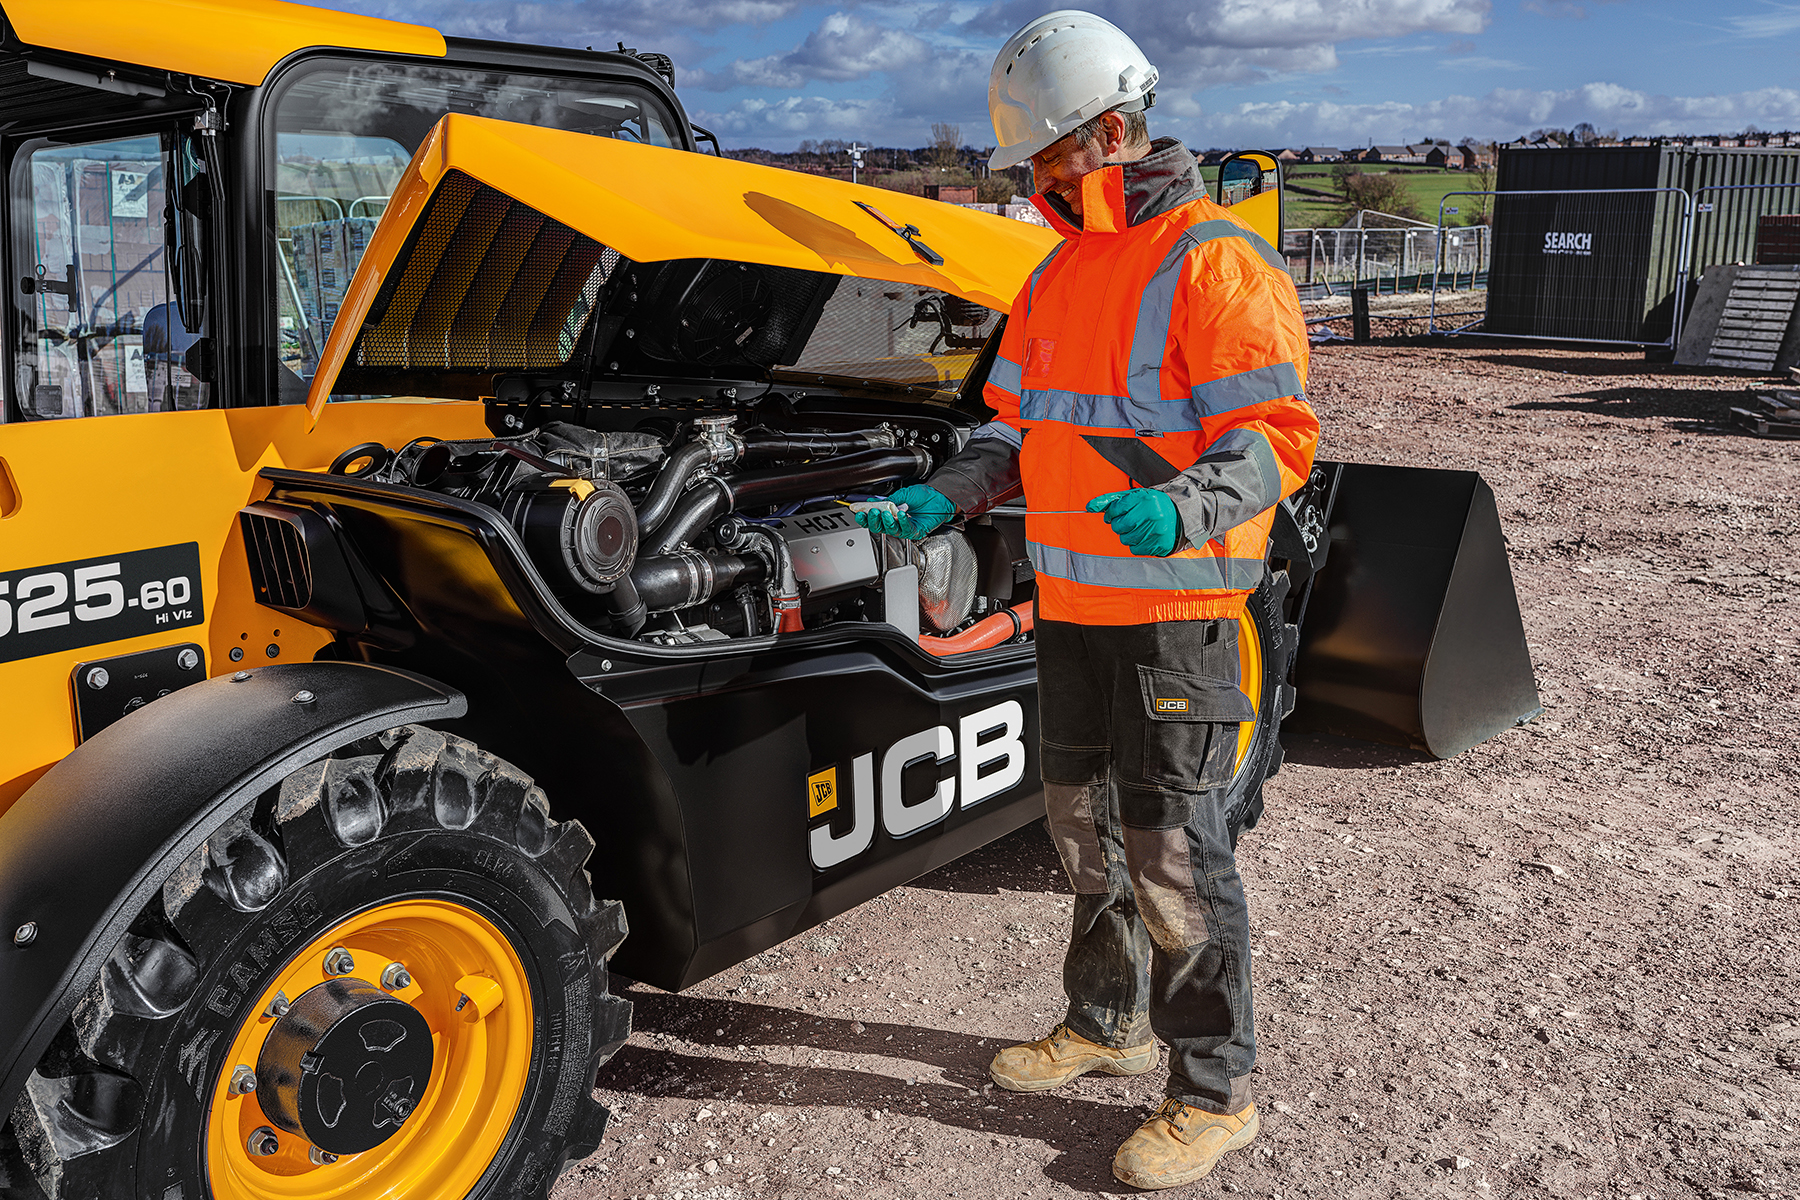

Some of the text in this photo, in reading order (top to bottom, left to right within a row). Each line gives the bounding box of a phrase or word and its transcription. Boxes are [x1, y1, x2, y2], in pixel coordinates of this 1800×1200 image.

[1544, 232, 1592, 250] SEARCH
[793, 512, 850, 534] HOT
[155, 612, 169, 625] Hi
[1159, 701, 1186, 710] JCB
[809, 700, 1026, 869] JCB
[815, 782, 832, 803] JCB
[206, 891, 324, 1019] CAMSO
